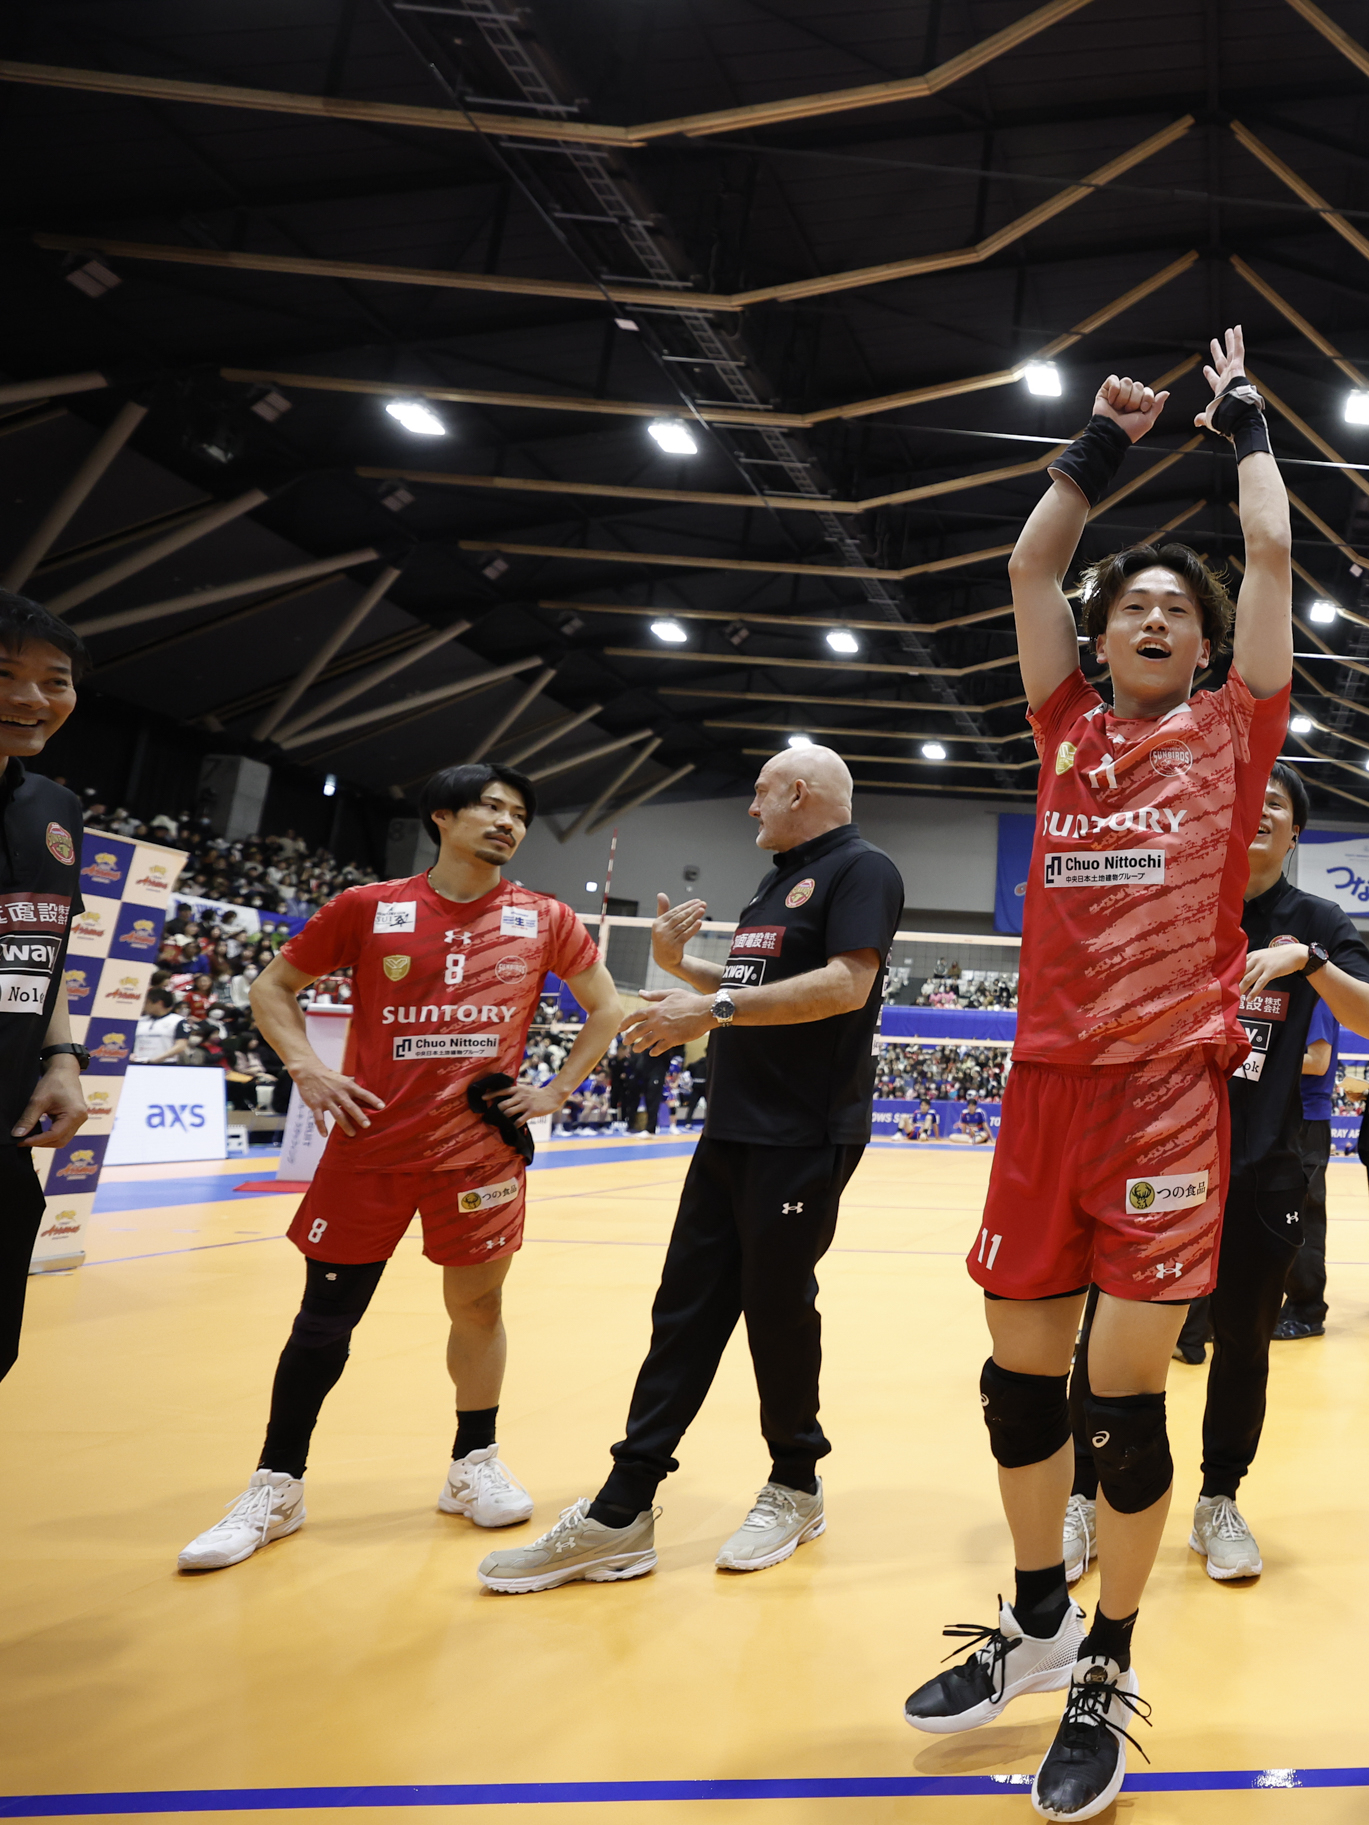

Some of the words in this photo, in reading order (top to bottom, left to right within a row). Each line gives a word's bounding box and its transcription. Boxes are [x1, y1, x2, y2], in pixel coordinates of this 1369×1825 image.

[1066, 857, 1100, 870] Chuo
[1104, 854, 1162, 869] Nittochi
[1065, 872, 1146, 883] 中央日本土地建物グループ
[443, 953, 466, 985] 8
[382, 1004, 517, 1025] SUNTORY
[415, 1038, 446, 1048] Chuo
[450, 1037, 497, 1048] Nittochi
[146, 1103, 205, 1133] axs
[482, 1184, 518, 1201] つの食品
[1156, 1181, 1206, 1199] つの食品
[307, 1217, 328, 1244] 8
[977, 1227, 1003, 1271] 11
